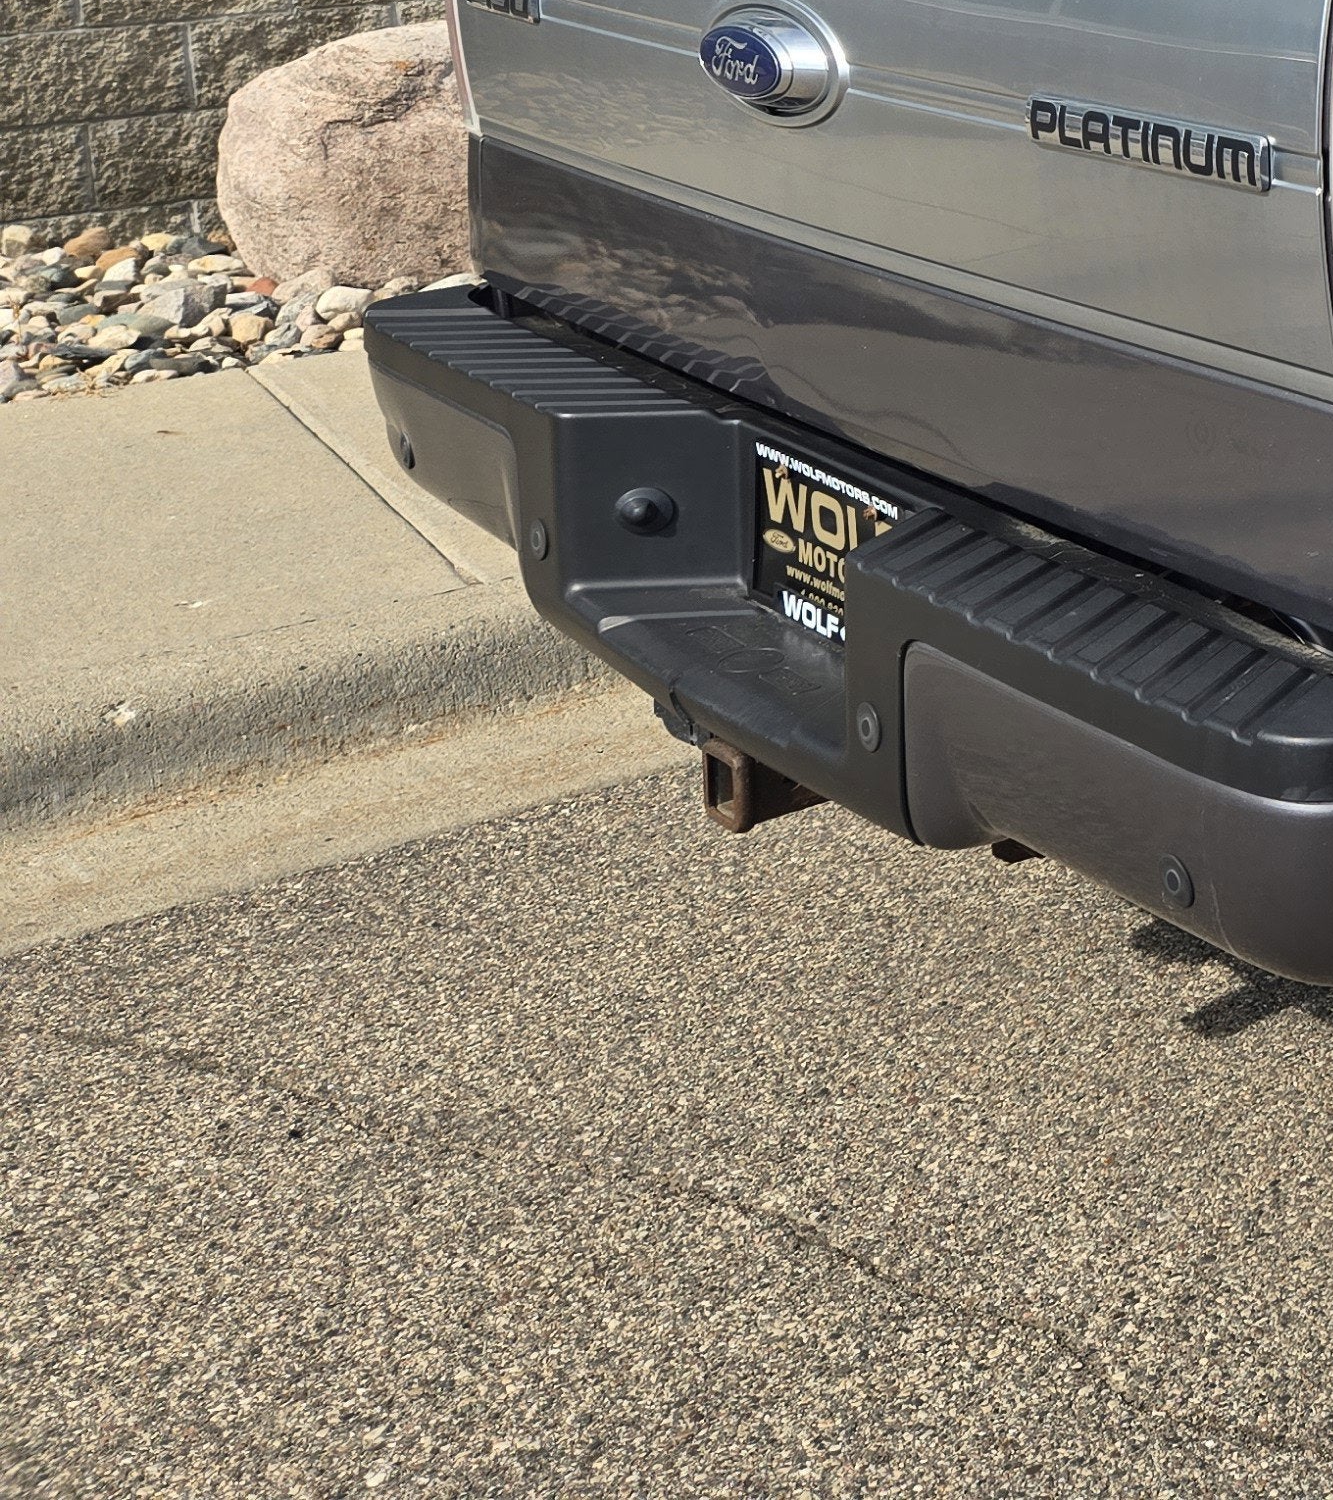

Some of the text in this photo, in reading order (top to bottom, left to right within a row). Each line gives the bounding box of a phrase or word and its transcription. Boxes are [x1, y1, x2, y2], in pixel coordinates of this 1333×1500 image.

[711, 36, 759, 86] Ford
[1029, 99, 1257, 187] PLATINUM
[755, 441, 899, 520] WWW.WOLFMOTORS.COM
[782, 590, 839, 639] WOLF
